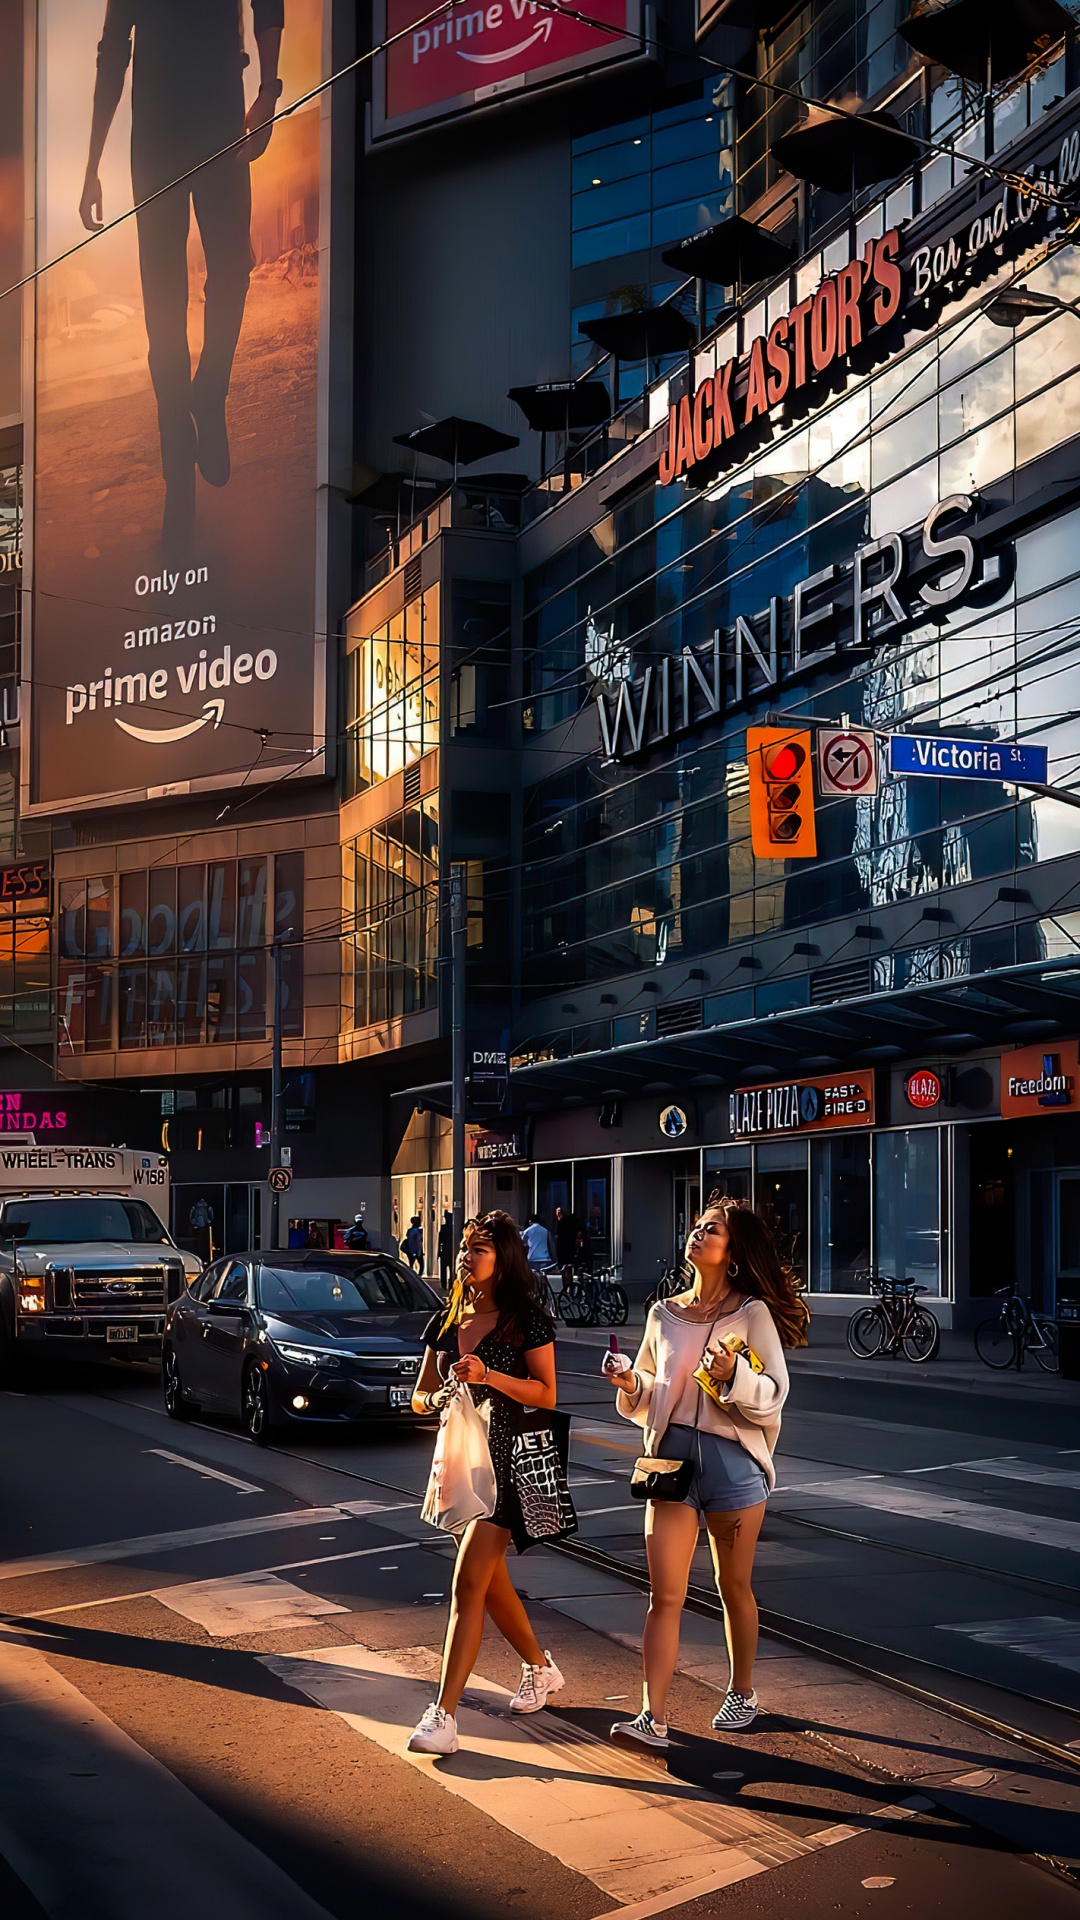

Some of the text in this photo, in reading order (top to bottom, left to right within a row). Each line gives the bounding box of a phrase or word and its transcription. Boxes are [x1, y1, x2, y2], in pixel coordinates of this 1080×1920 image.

[412, 3, 503, 64] prime
[659, 362, 735, 486] JACK
[745, 228, 901, 426] ASTOR'S
[910, 246, 961, 297] Bar
[965, 186, 1009, 257] and
[134, 566, 208, 596] Only on
[124, 614, 216, 649] amazon
[597, 494, 976, 767] WINNERS
[66, 645, 278, 725] prime video
[915, 740, 1001, 771] Victoria
[1008, 1070, 1066, 1097] Freedom
[0, 1093, 21, 1111] N
[766, 1084, 799, 1130] PIZZA
[0, 1111, 67, 1129] NDAS
[2, 1151, 116, 1169] WHEEL-TRANS
